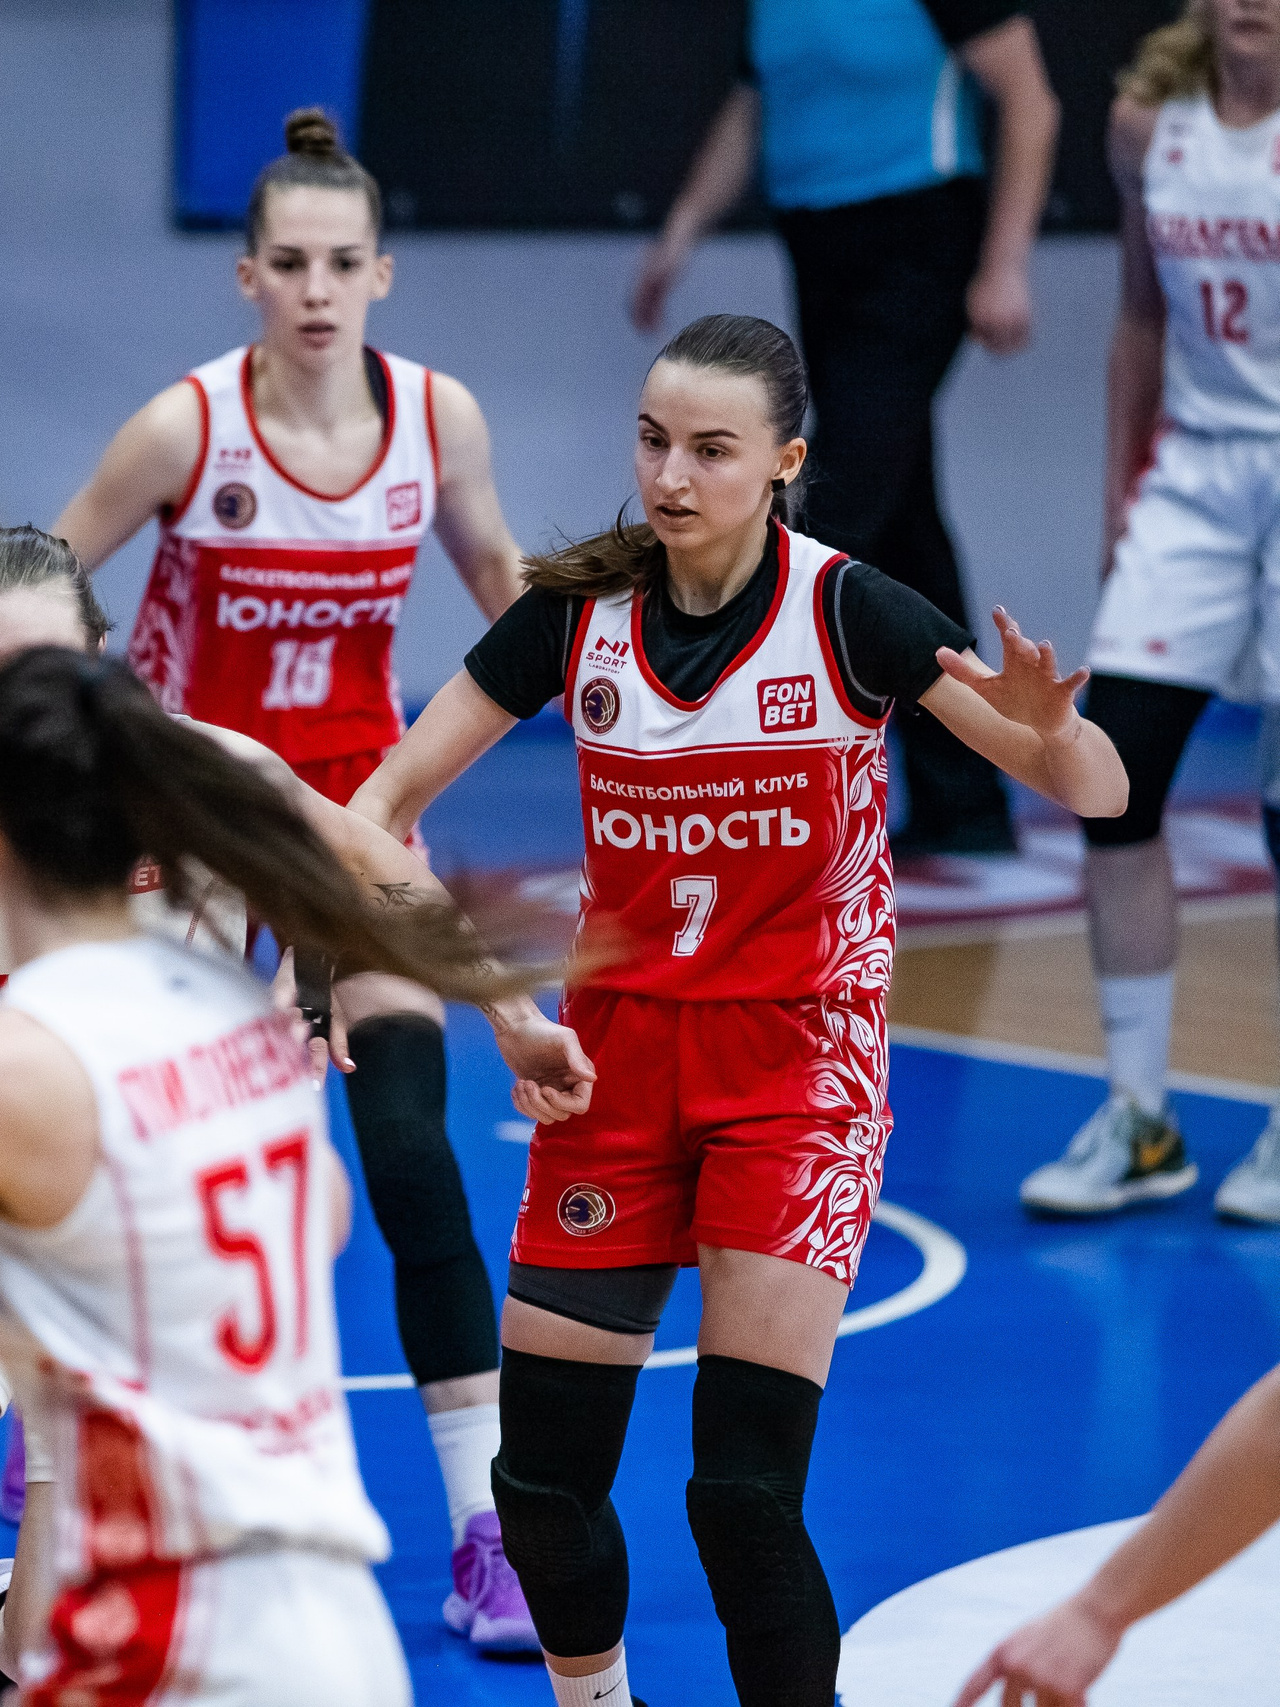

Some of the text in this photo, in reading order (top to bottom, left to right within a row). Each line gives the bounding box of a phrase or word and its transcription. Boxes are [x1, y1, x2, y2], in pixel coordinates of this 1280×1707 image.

[1200, 280, 1250, 343] 12
[586, 652, 627, 668] SPORT
[762, 681, 811, 705] FON
[764, 701, 813, 727] BET
[590, 773, 809, 801] БАСКЕТБОЛЬНЫЙ КЛУБ
[591, 806, 811, 855] ЮНОСТЬ
[671, 875, 718, 957] 7
[196, 1127, 309, 1373] 57
